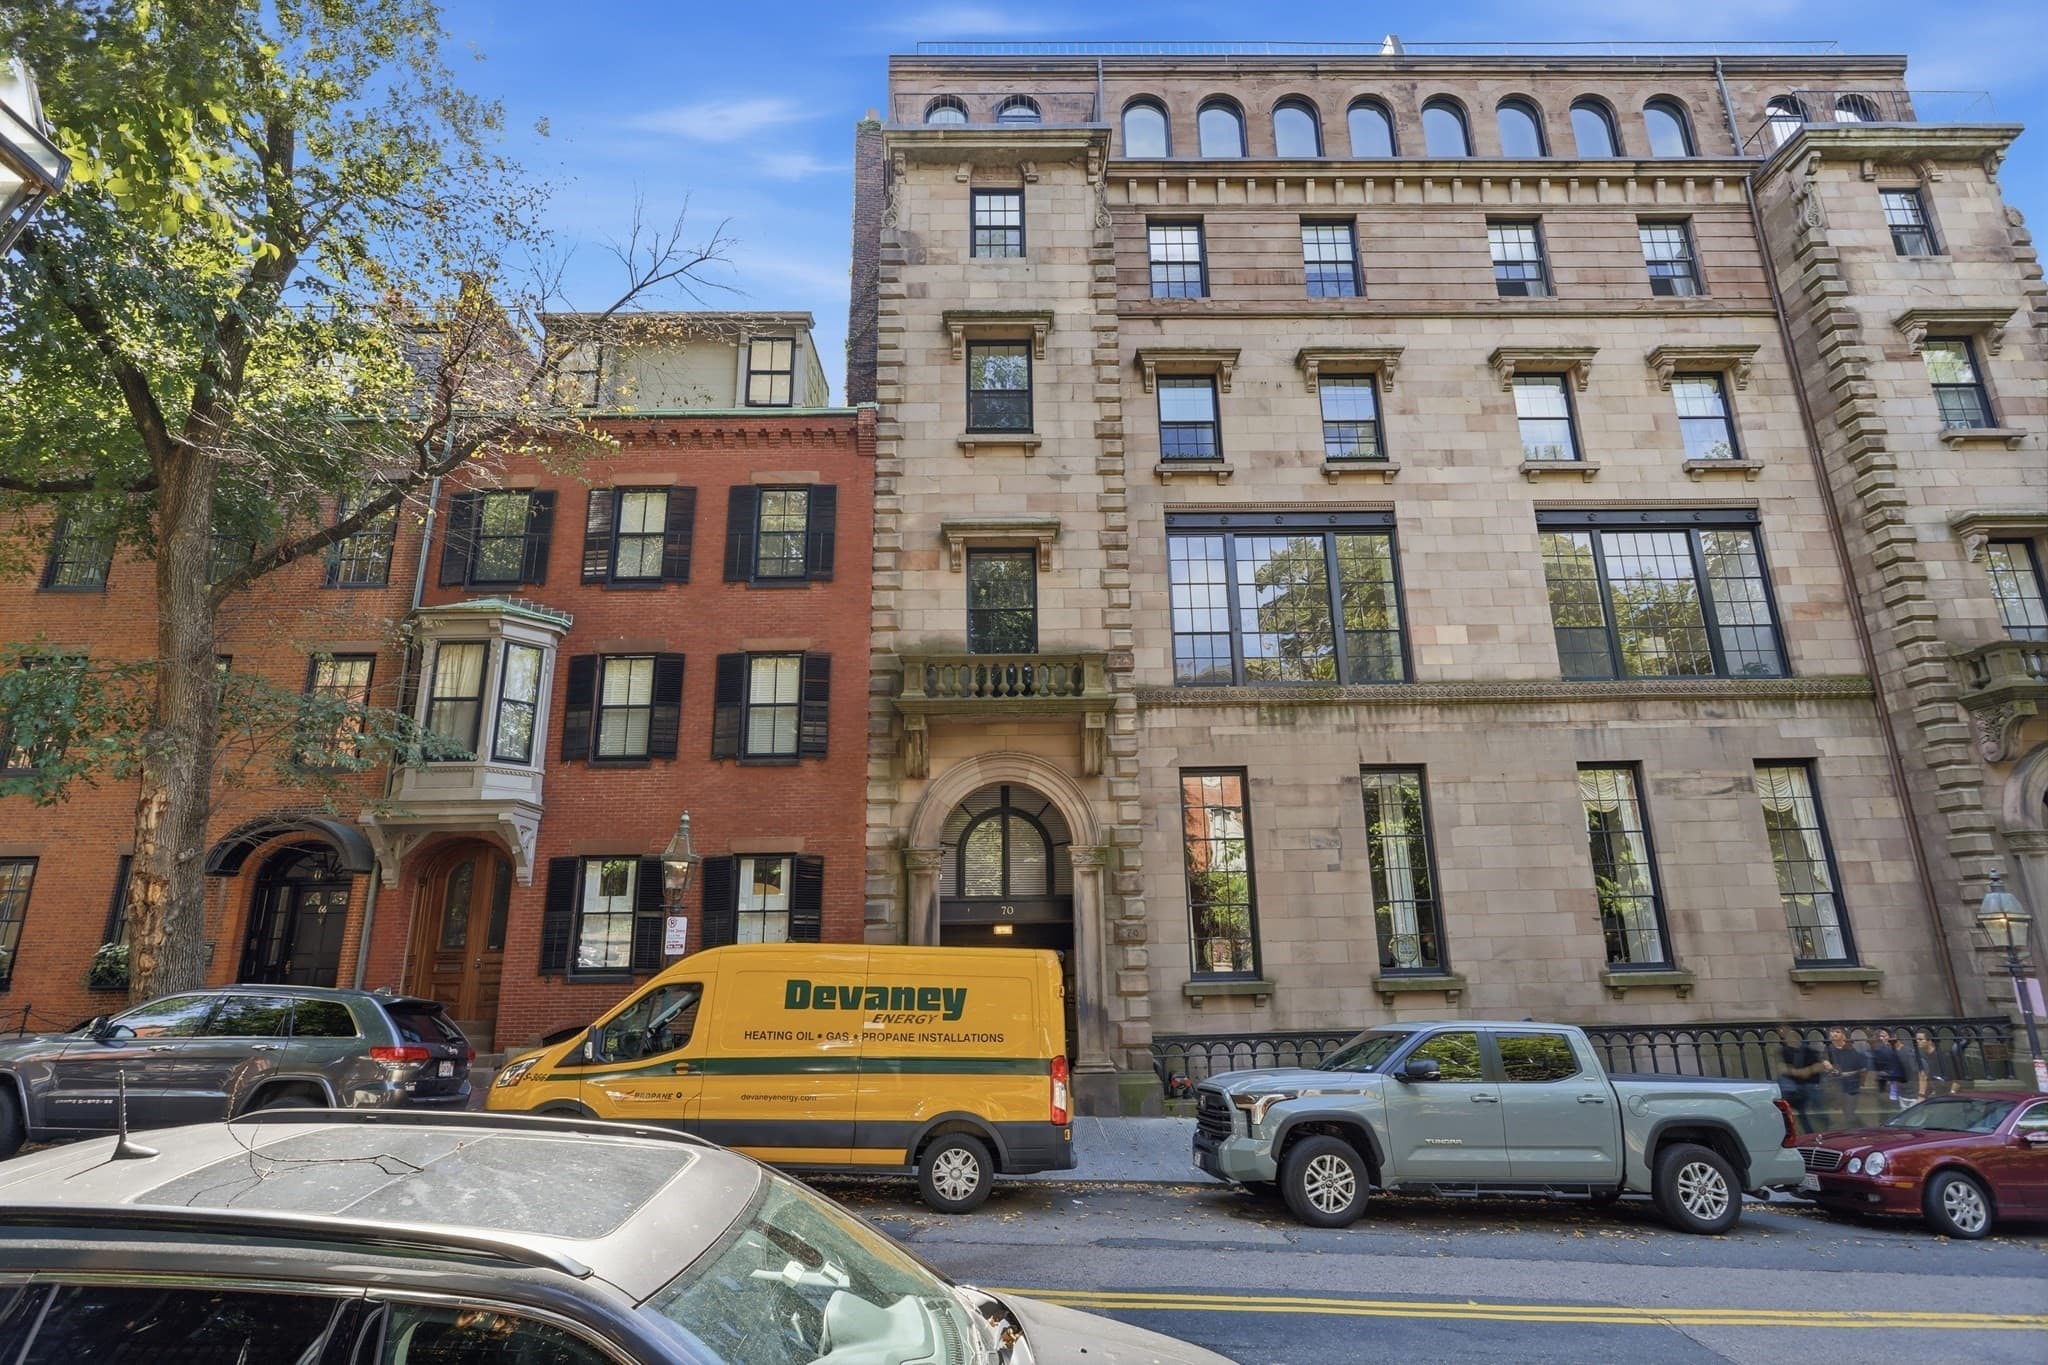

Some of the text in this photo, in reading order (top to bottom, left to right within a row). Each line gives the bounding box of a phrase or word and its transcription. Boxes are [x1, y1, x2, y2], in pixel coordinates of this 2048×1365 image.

[1001, 905, 1014, 915] 70
[784, 980, 967, 1021] Devaney
[872, 1013, 938, 1024] ENERGY
[744, 1031, 1005, 1043] HEATING OIL GAS PROPANE INSTALLATIONS
[740, 1093, 817, 1103] devaneyenergy.com
